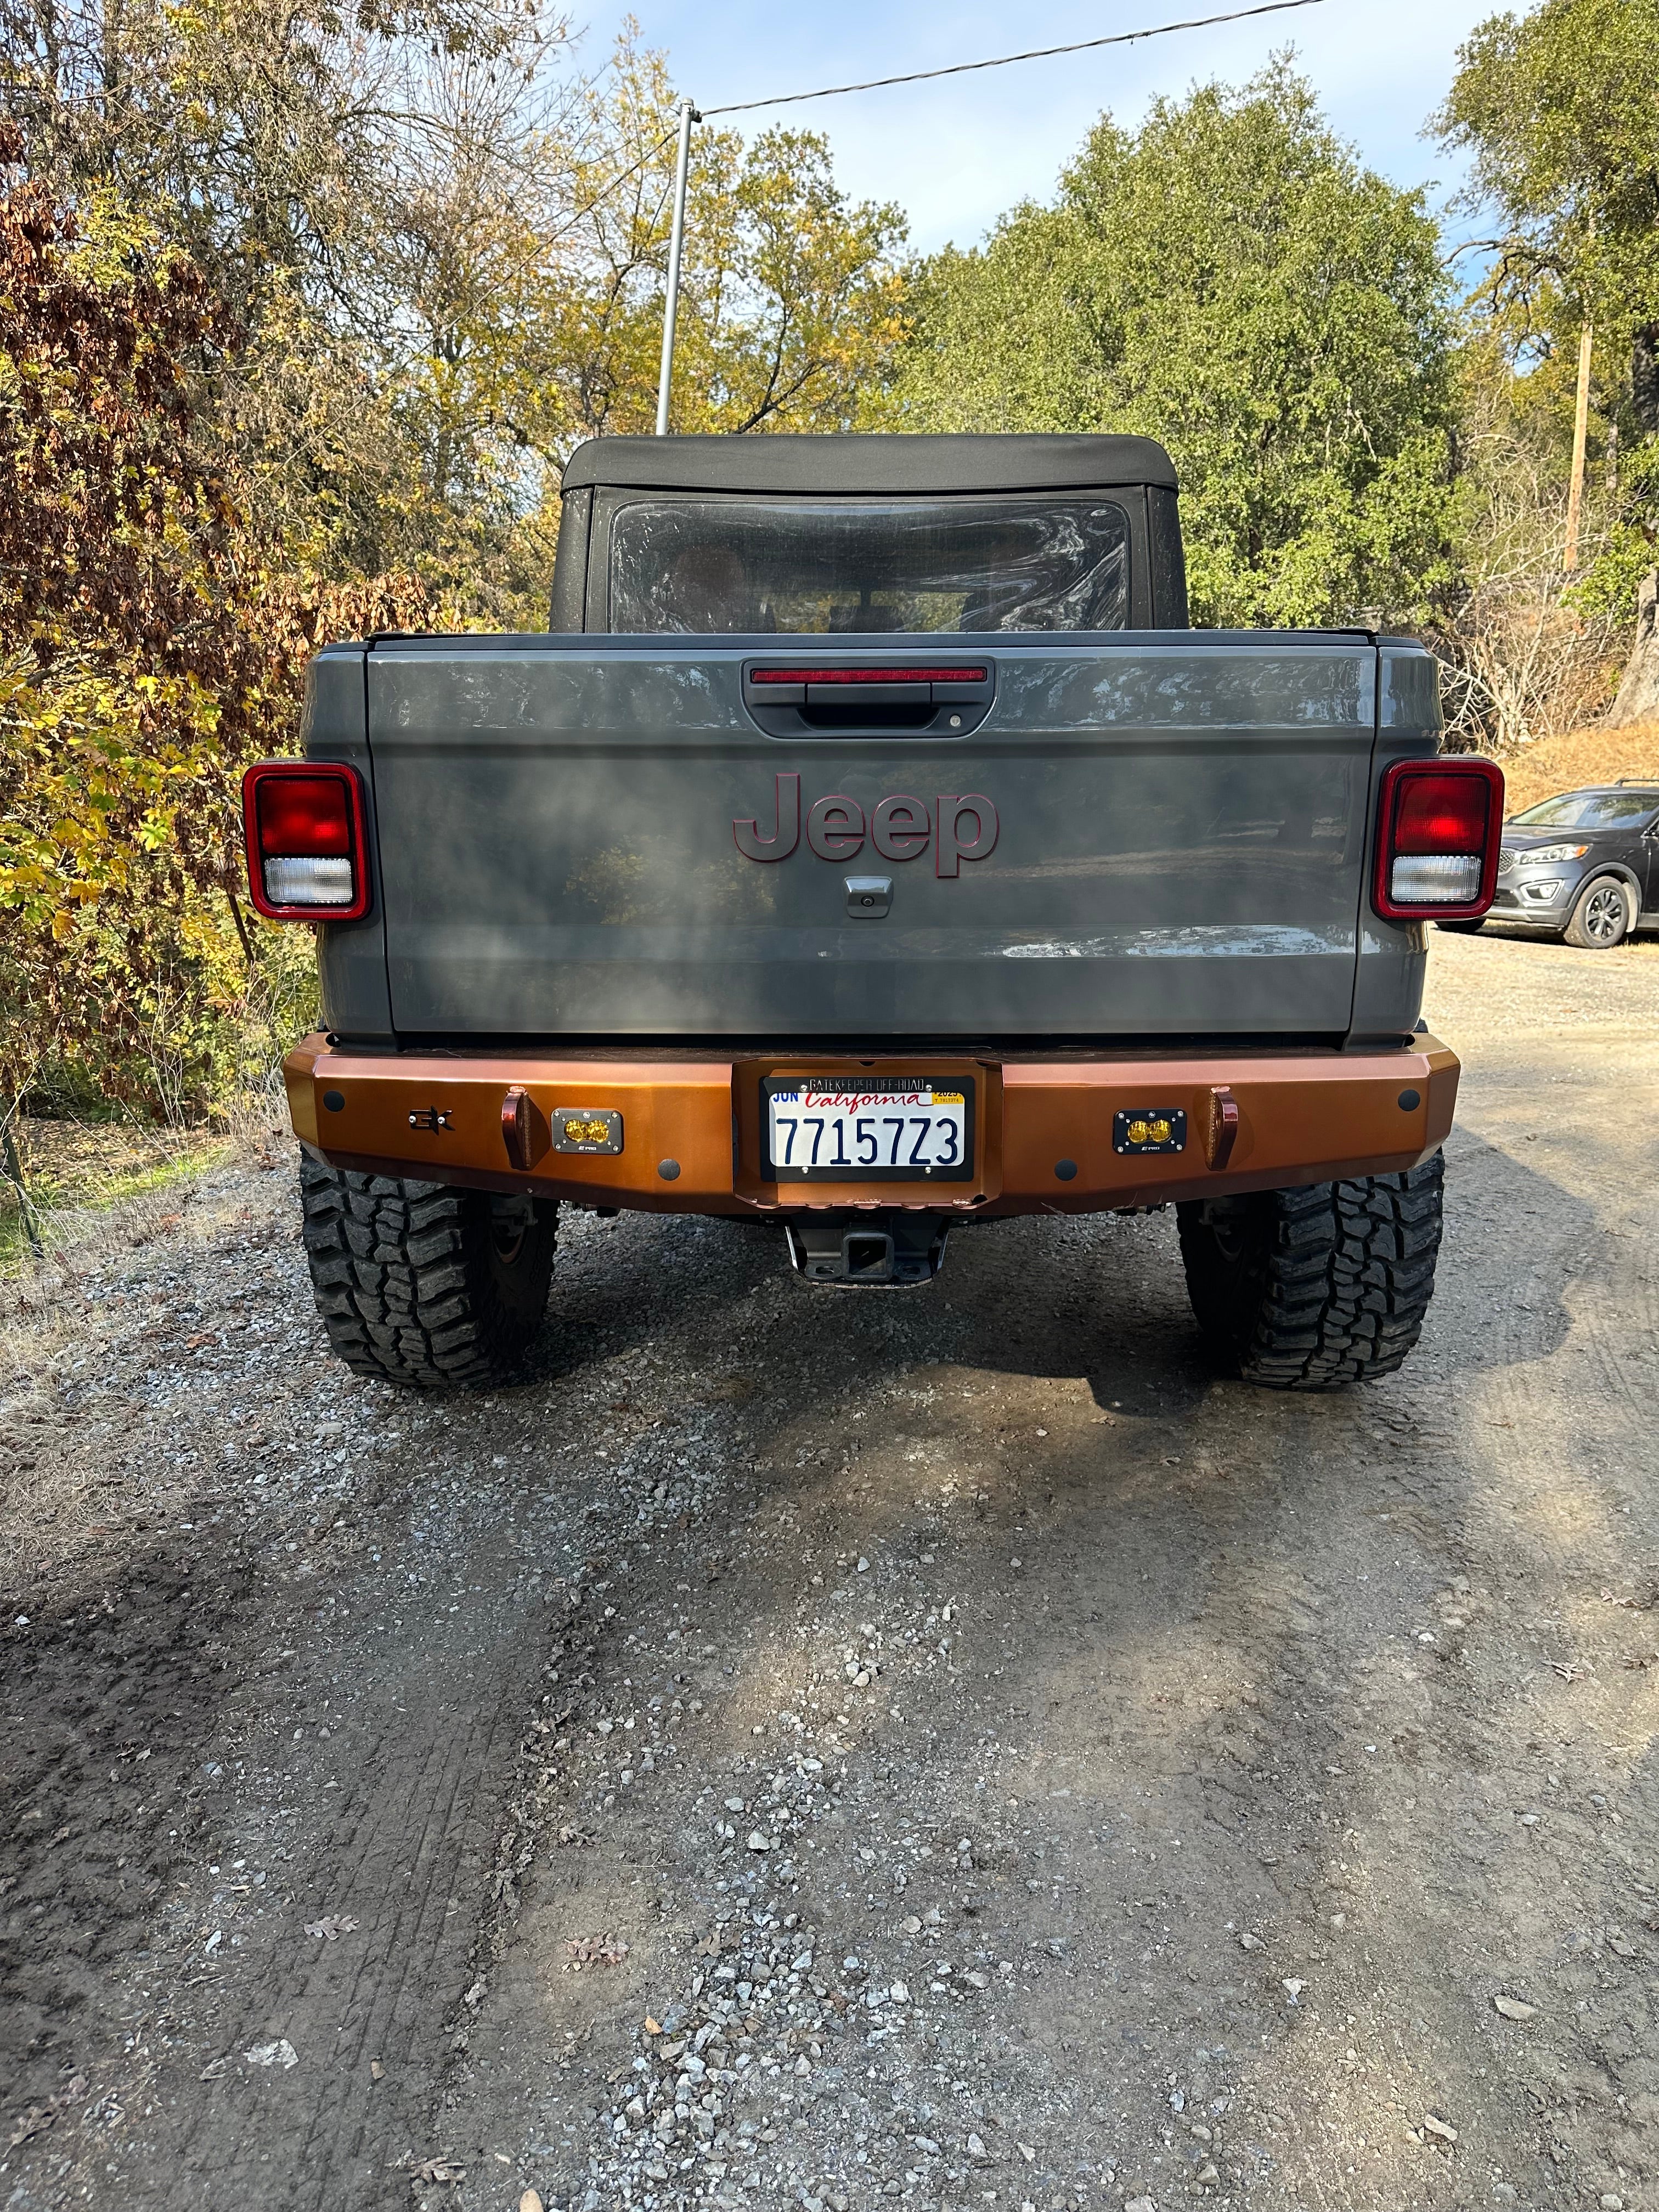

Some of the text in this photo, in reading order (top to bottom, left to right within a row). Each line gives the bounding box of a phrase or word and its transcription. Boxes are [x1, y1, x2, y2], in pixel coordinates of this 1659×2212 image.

[733, 773, 1000, 878] Jeep
[809, 1079, 924, 1091] GATEKEEPER OFF-ROAD
[773, 1092, 798, 1102] JUN
[805, 1092, 934, 1115] California
[776, 1118, 958, 1165] 77157Z3
